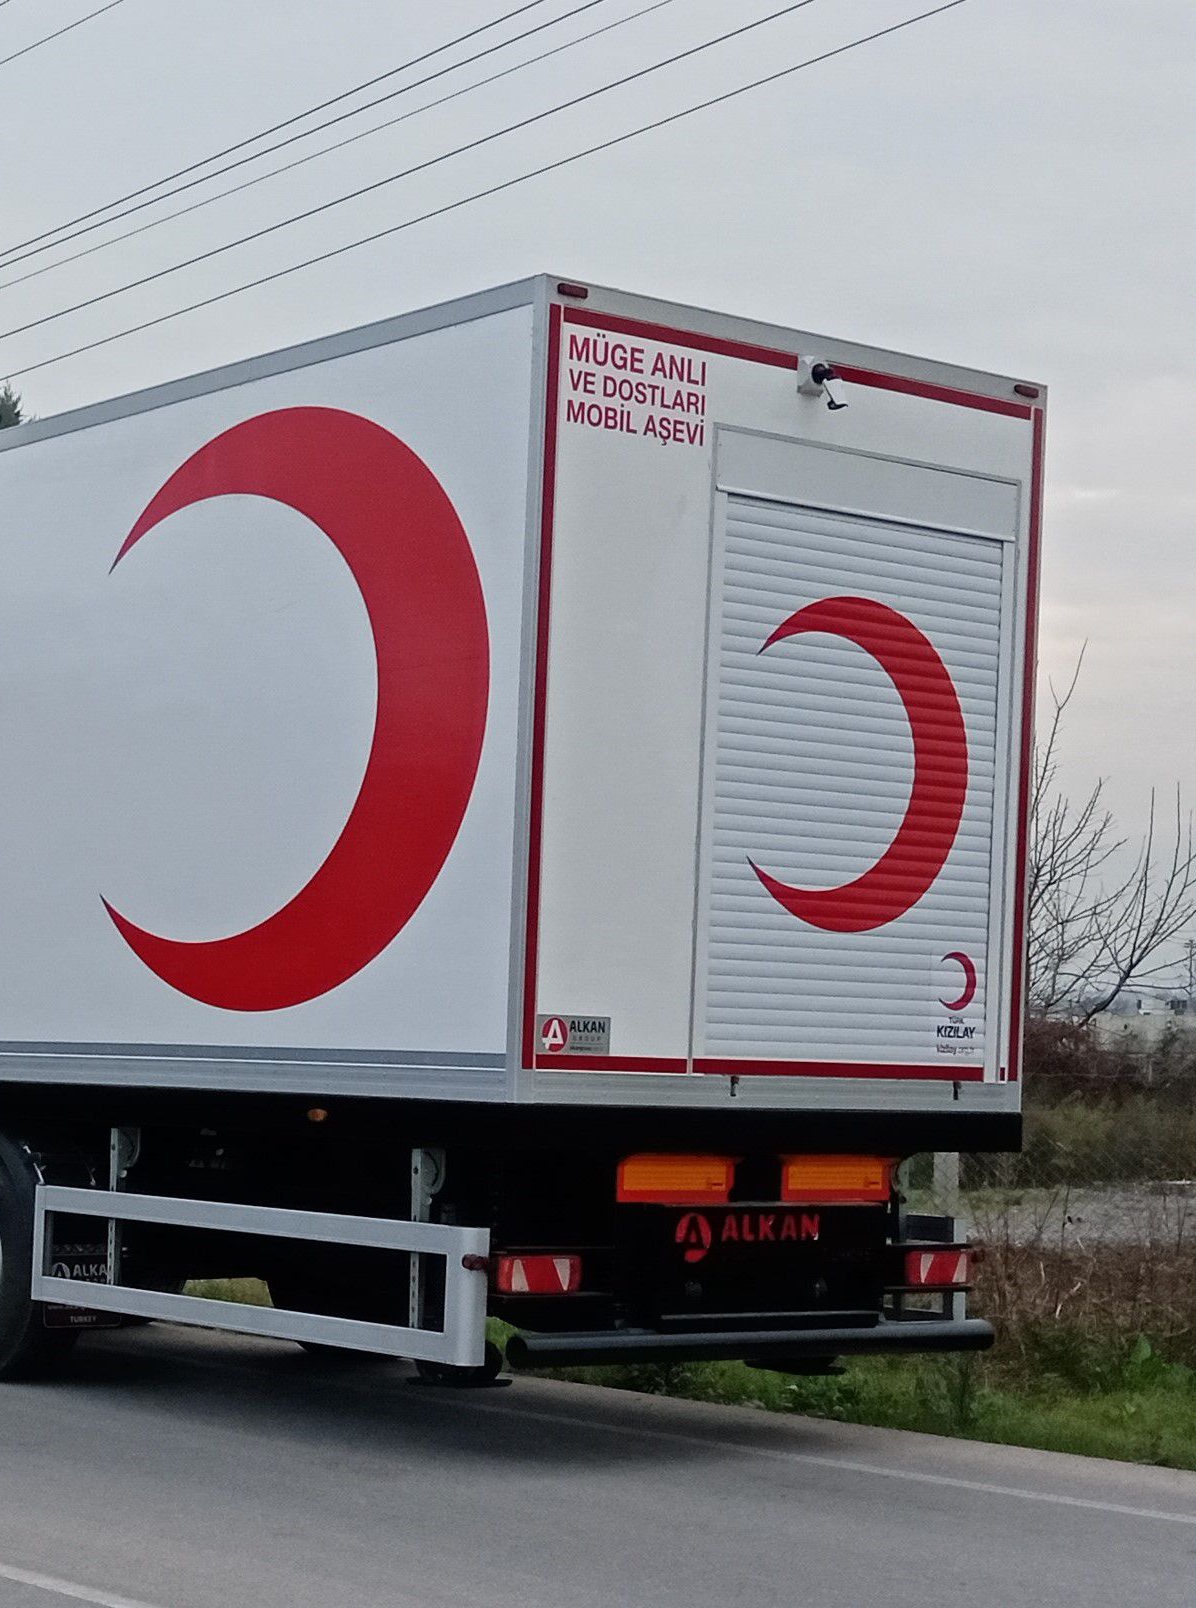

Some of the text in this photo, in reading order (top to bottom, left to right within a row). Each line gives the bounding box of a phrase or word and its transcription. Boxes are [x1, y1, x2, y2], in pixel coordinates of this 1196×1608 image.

[568, 332, 707, 387] MÜGE ANLI
[568, 368, 706, 416] VE DOSTLARI
[566, 399, 705, 447] MOBİL AŞEVİ
[569, 1020, 606, 1033] ALKAN
[936, 1025, 976, 1039] KIZILAY
[720, 1213, 821, 1242] ALKAN
[72, 1263, 109, 1277] ALKA
